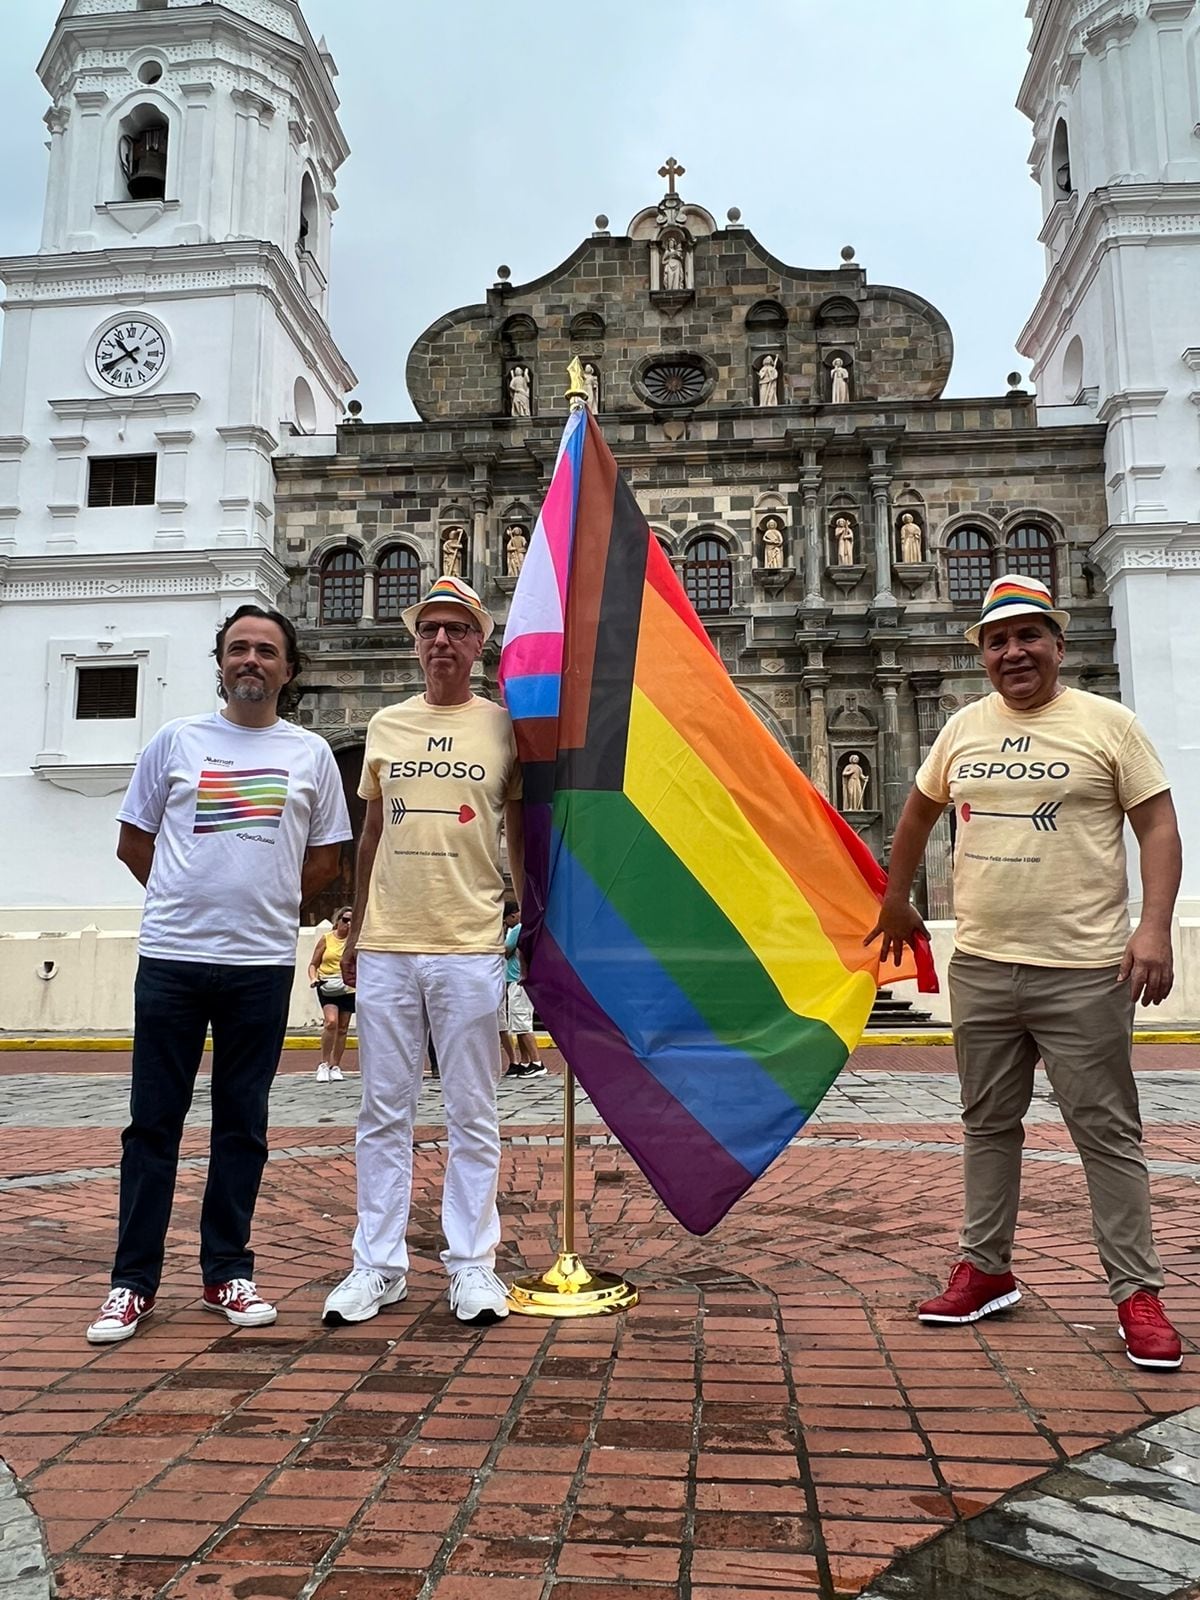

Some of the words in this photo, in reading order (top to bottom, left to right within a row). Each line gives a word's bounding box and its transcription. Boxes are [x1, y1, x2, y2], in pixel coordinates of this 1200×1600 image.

[427, 737, 453, 752] MI
[1001, 736, 1031, 752] MI
[390, 761, 485, 781] ESPOSO
[957, 762, 1070, 780] ESPOSO
